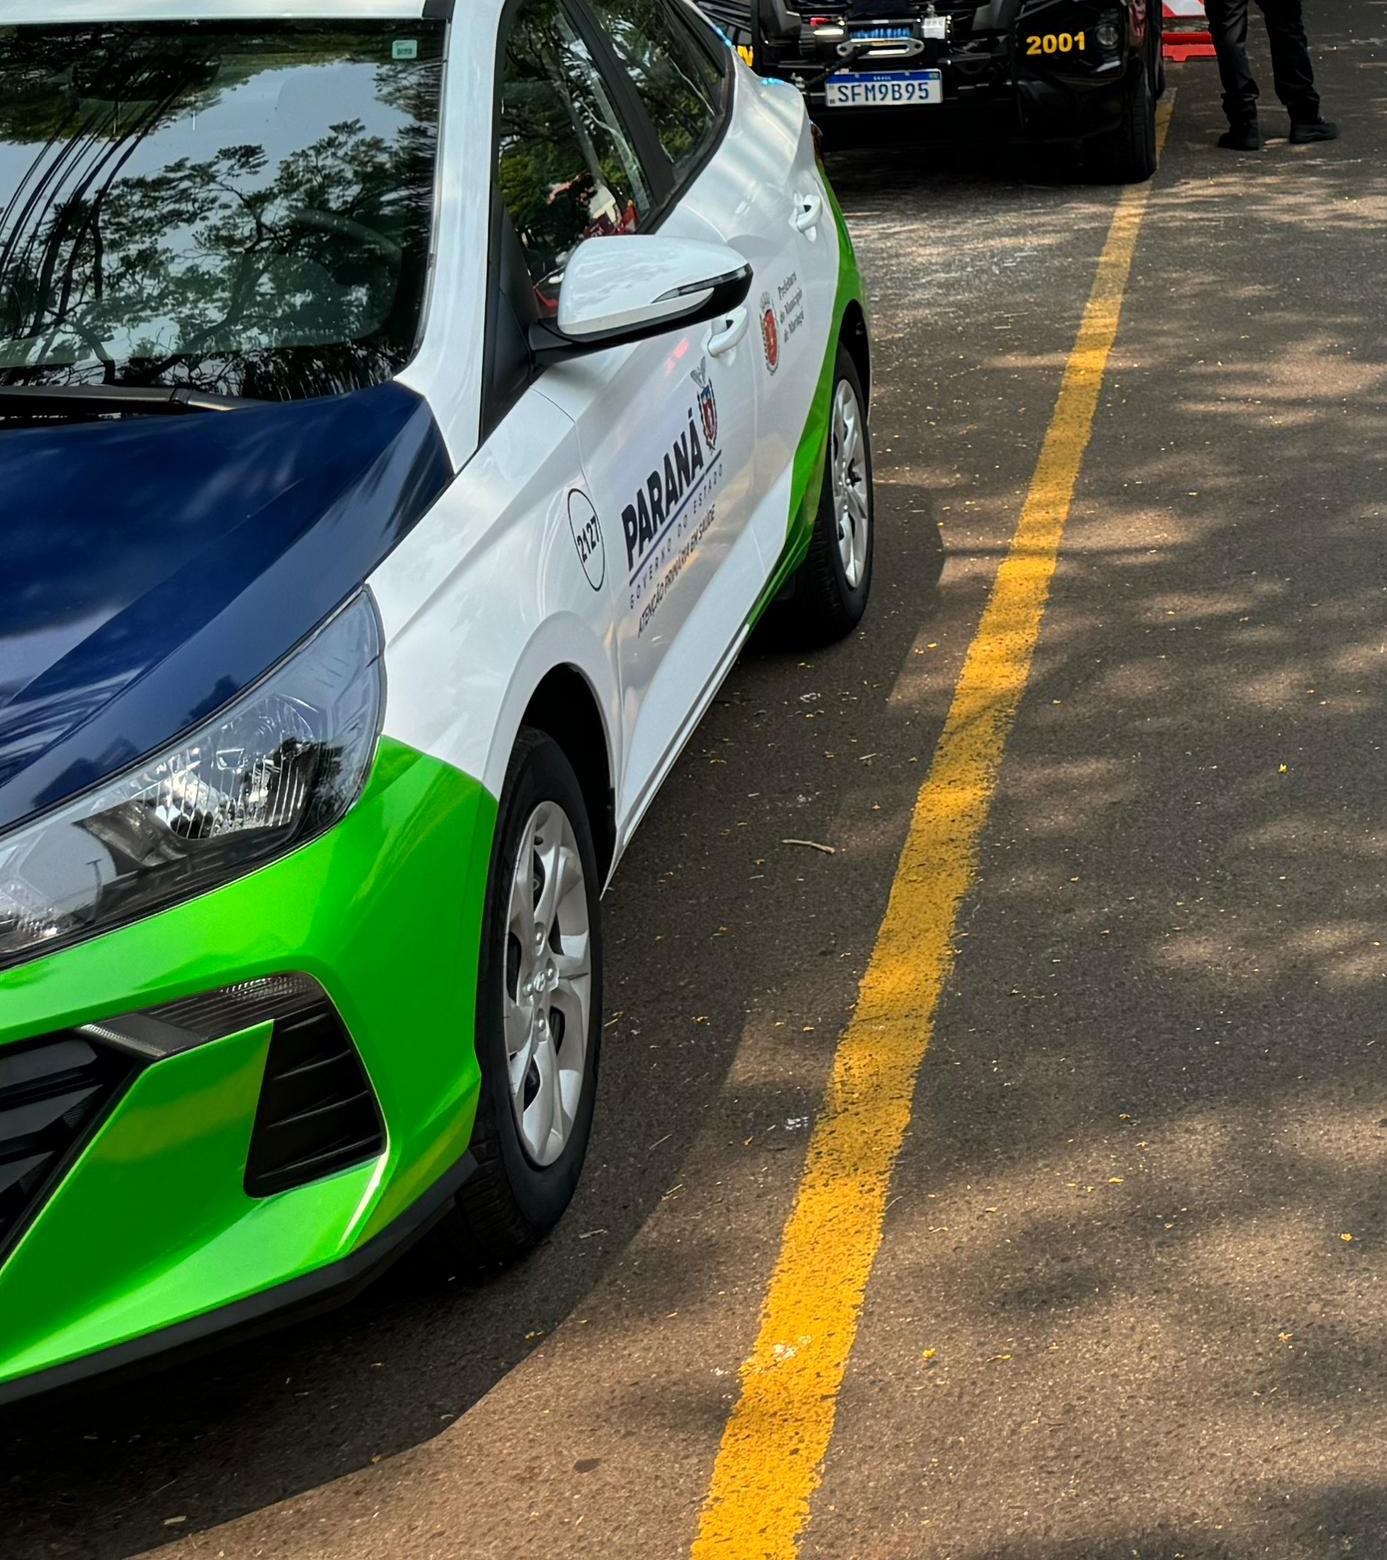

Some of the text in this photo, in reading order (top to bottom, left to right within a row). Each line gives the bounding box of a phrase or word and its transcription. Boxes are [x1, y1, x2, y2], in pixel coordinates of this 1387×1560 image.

[1026, 31, 1086, 55] 2001
[837, 82, 930, 103] SFM9B95
[621, 407, 704, 572] PARANÁ
[577, 515, 601, 563] 2127
[629, 463, 723, 609] GOVERNO DO ESTADO
[636, 581, 664, 638] ATENÇÃO
